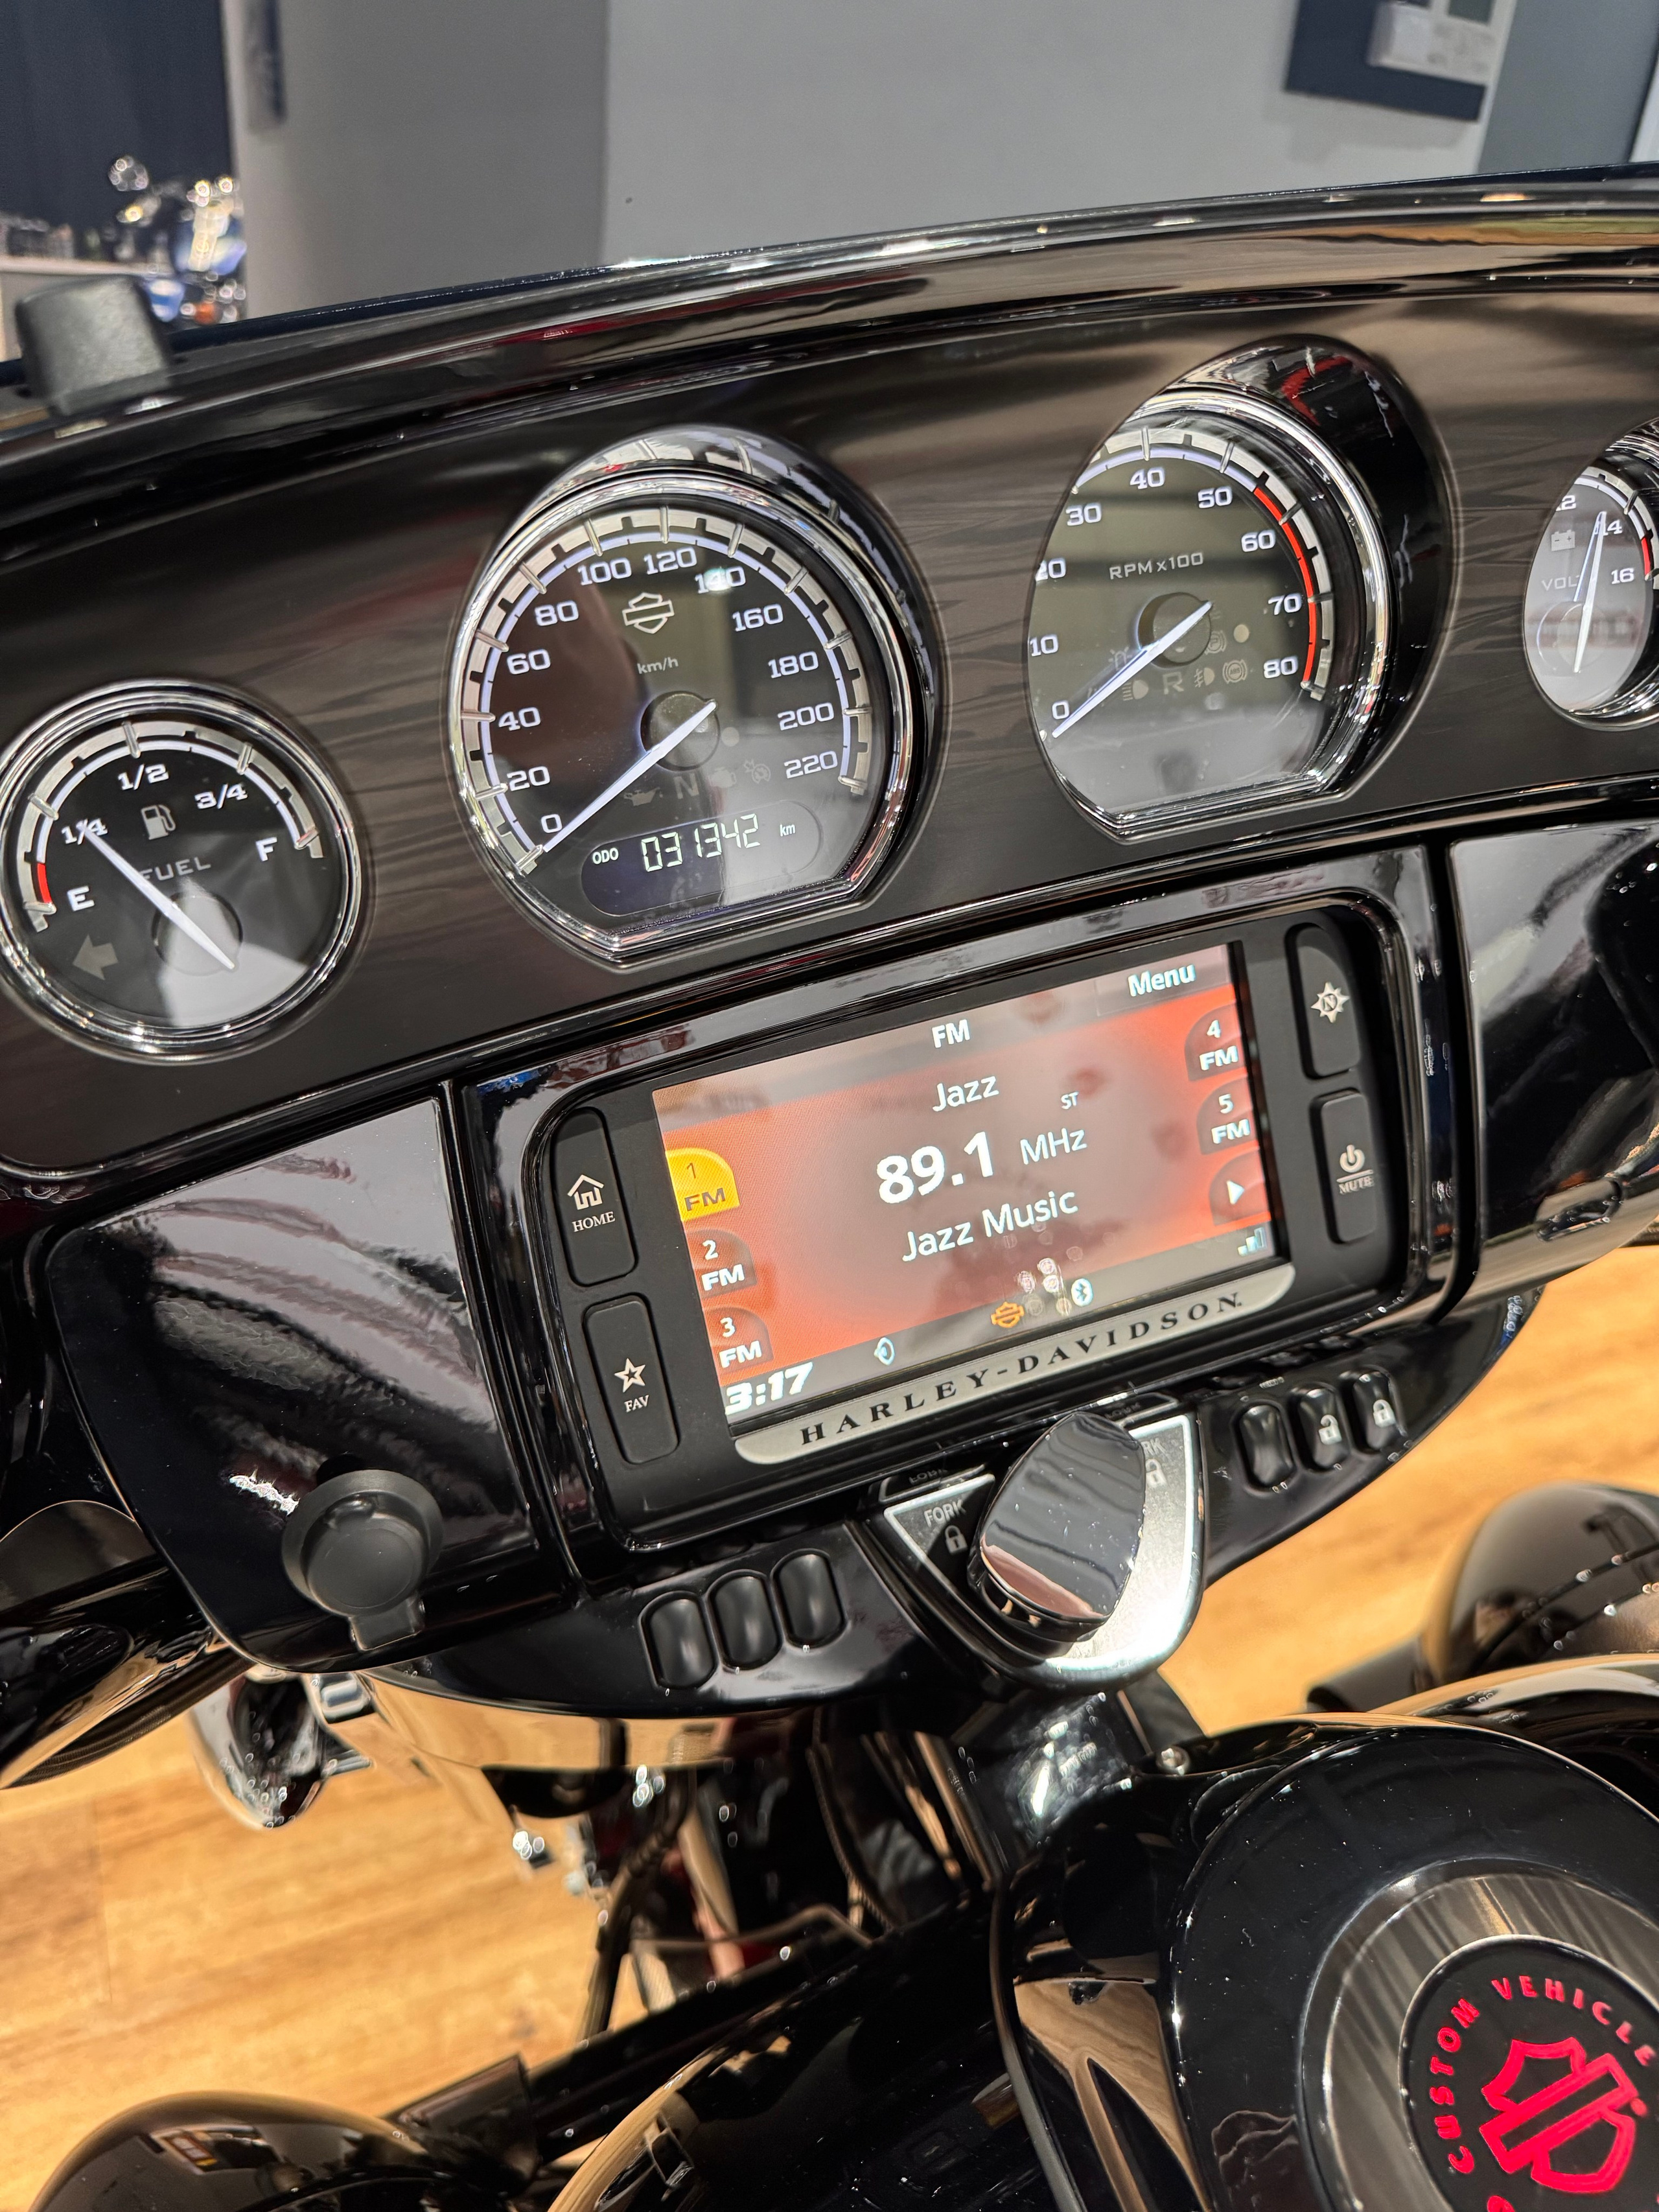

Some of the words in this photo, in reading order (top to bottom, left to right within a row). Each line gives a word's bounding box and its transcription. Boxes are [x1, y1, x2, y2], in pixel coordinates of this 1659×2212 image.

[1130, 469, 1165, 489] 40
[1198, 487, 1233, 508] 50
[1556, 495, 1577, 511] 2
[1066, 504, 1102, 526] 30
[1241, 530, 1276, 552] 60
[577, 558, 632, 585] 100
[643, 547, 697, 575] 120
[695, 566, 746, 594] 140
[1611, 568, 1634, 585] 16
[535, 600, 579, 627] 80
[1268, 593, 1302, 615] 70
[732, 603, 783, 632] 160
[1030, 634, 1058, 657] 10
[507, 649, 551, 675] 60
[637, 656, 679, 675] km/h
[768, 652, 819, 679] 180
[1263, 657, 1298, 679] 80
[498, 708, 540, 732] 40
[778, 703, 834, 730] 200
[1052, 700, 1069, 720] 0
[118, 763, 169, 791] 1/2
[783, 751, 837, 778] 220
[506, 766, 550, 792] 20
[194, 784, 248, 810] 3/4
[62, 818, 108, 844] 1/4
[542, 814, 562, 833] 0
[255, 837, 277, 861] F
[592, 847, 619, 865] ODO
[641, 813, 761, 872] 031342
[780, 824, 796, 837] km
[67, 885, 95, 911] E
[1128, 964, 1197, 998] Menu
[932, 1019, 970, 1049] FM
[1207, 1020, 1221, 1038] 4
[1200, 1045, 1238, 1071] FM
[932, 1075, 999, 1113] Jazz
[1060, 1091, 1078, 1110] ST
[1219, 1094, 1233, 1113] 5
[1211, 1119, 1250, 1144] FM
[686, 1163, 697, 1179] 1
[877, 1131, 993, 1205] 89.1
[1020, 1128, 1087, 1165] MHz
[684, 1188, 726, 1211] FM
[572, 1211, 616, 1233] HOME
[901, 1220, 975, 1263] Jazz
[981, 1189, 1079, 1238] Music
[702, 1240, 719, 1260] 2
[701, 1264, 745, 1291] FM
[720, 1317, 736, 1336] 3
[719, 1341, 762, 1369] FM
[801, 1291, 1240, 1446] HARLEY-DAVIDSON
[725, 1362, 813, 1415] 3:17
[624, 1395, 649, 1412] FAV
[923, 1500, 966, 1528] FORK
[1430, 1998, 1480, 2174] CUSTOM
[1491, 1975, 1656, 2067] VEHICLE
